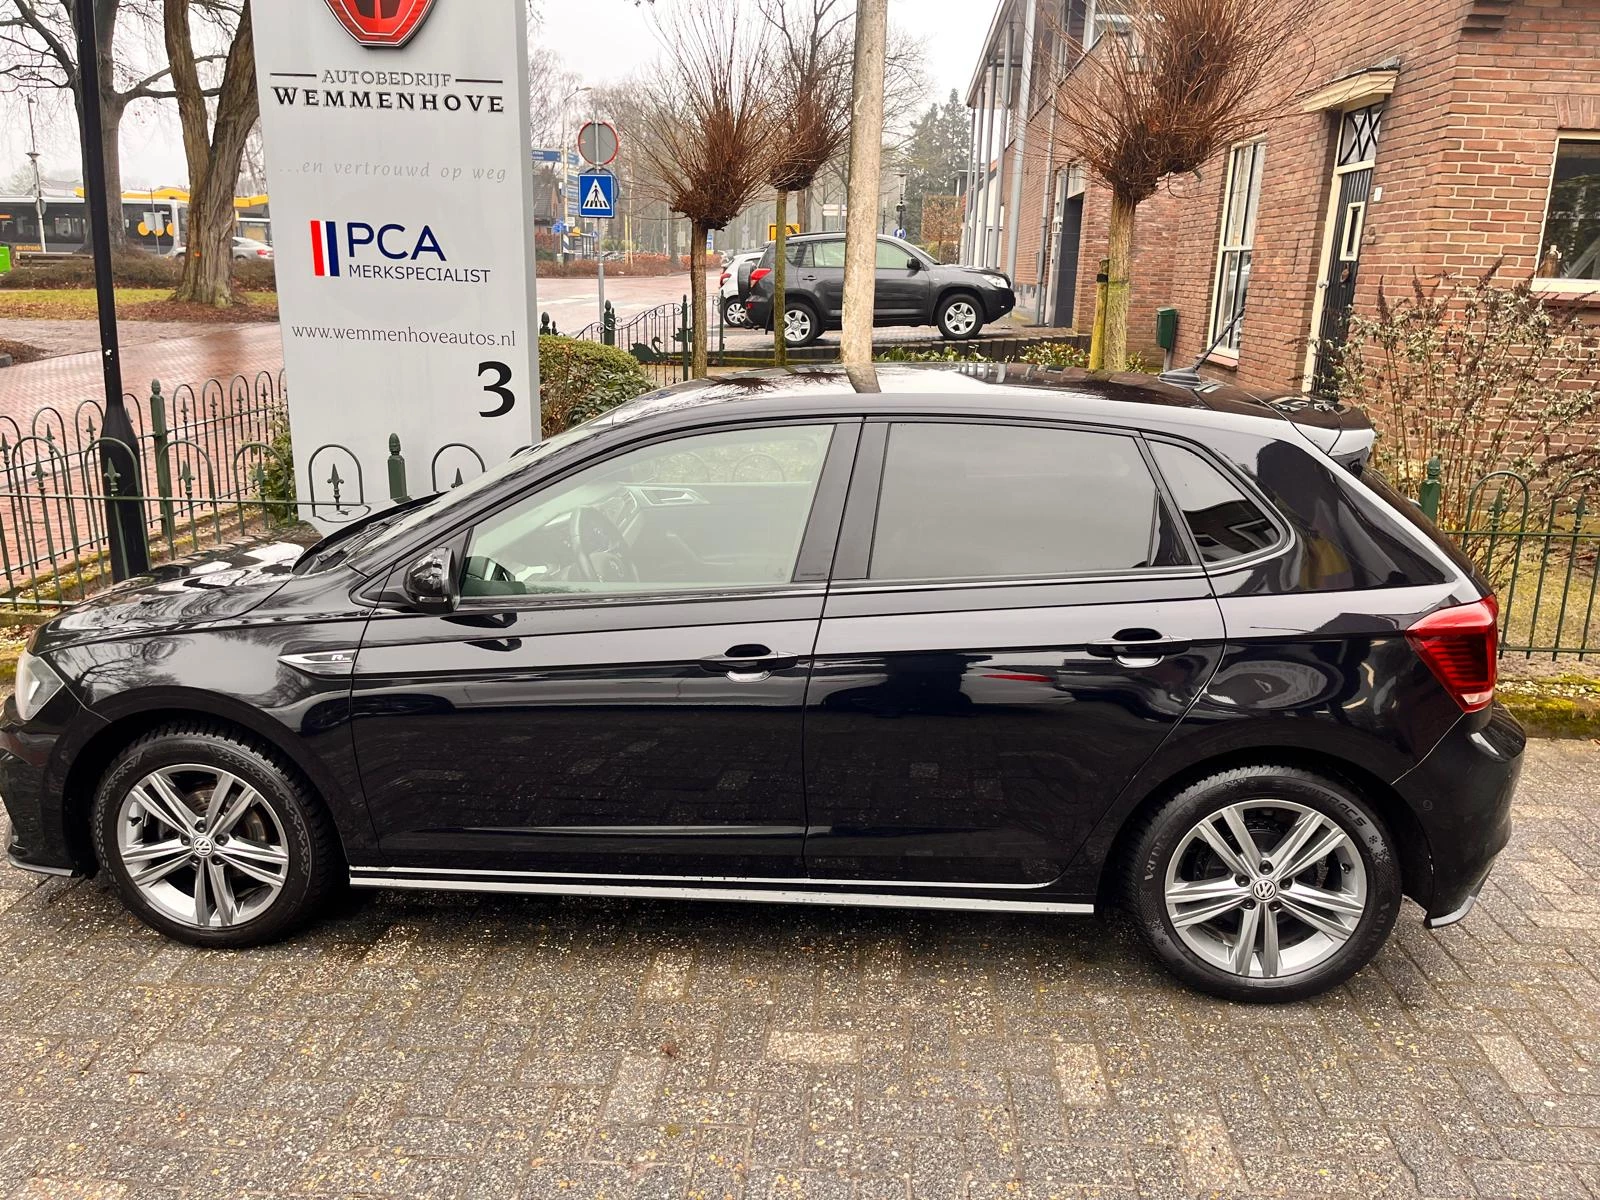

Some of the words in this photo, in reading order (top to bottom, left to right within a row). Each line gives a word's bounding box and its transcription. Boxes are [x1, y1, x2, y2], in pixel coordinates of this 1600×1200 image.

[322, 70, 452, 88] AUTOBEDRIJF
[270, 86, 505, 113] WEMMENHOVE
[333, 162, 430, 178] vertrouwd
[440, 167, 462, 182] op
[472, 168, 506, 183] weg
[346, 221, 448, 262] PCA
[348, 264, 491, 284] MERKSPECIALIST
[291, 326, 516, 347] www.wemmenhoveautos.nl
[477, 360, 516, 418] 3
